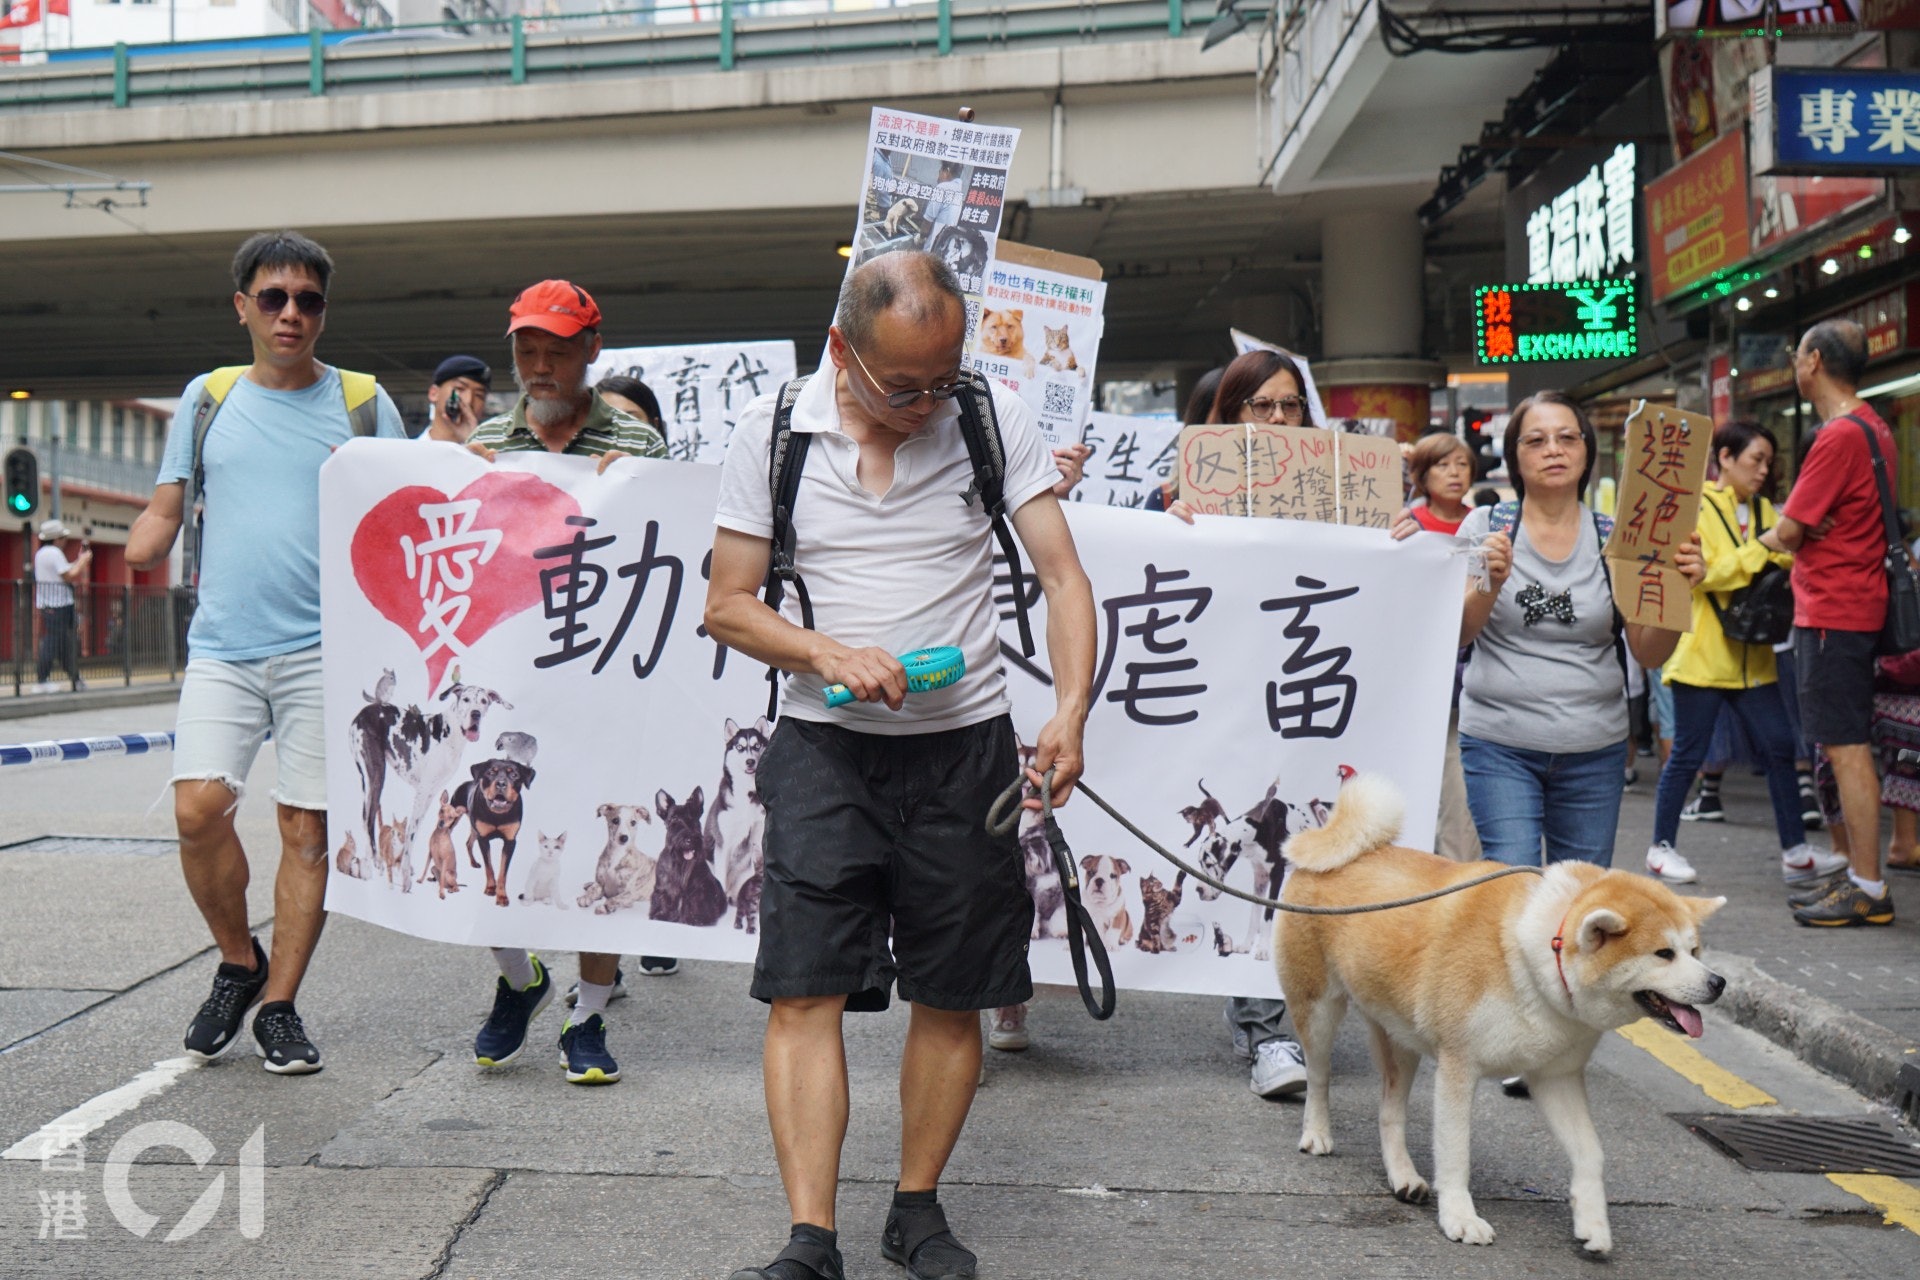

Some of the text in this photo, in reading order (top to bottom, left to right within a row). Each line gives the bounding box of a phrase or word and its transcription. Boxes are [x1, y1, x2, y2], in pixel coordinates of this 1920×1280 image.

[1797, 88, 1919, 154] 專業
[875, 131, 1010, 166] 反對政府撥款三千萬撲殺動物
[972, 172, 1006, 191] 去年政府
[961, 207, 990, 225] 條生命
[990, 270, 1093, 304] 物也有生存權利
[1518, 330, 1630, 357] EXCHANGE
[974, 359, 1009, 376] 月13日
[1194, 436, 1279, 485] 反對
[1292, 466, 1382, 501] 撥款
[1621, 420, 1694, 622] 選絕育
